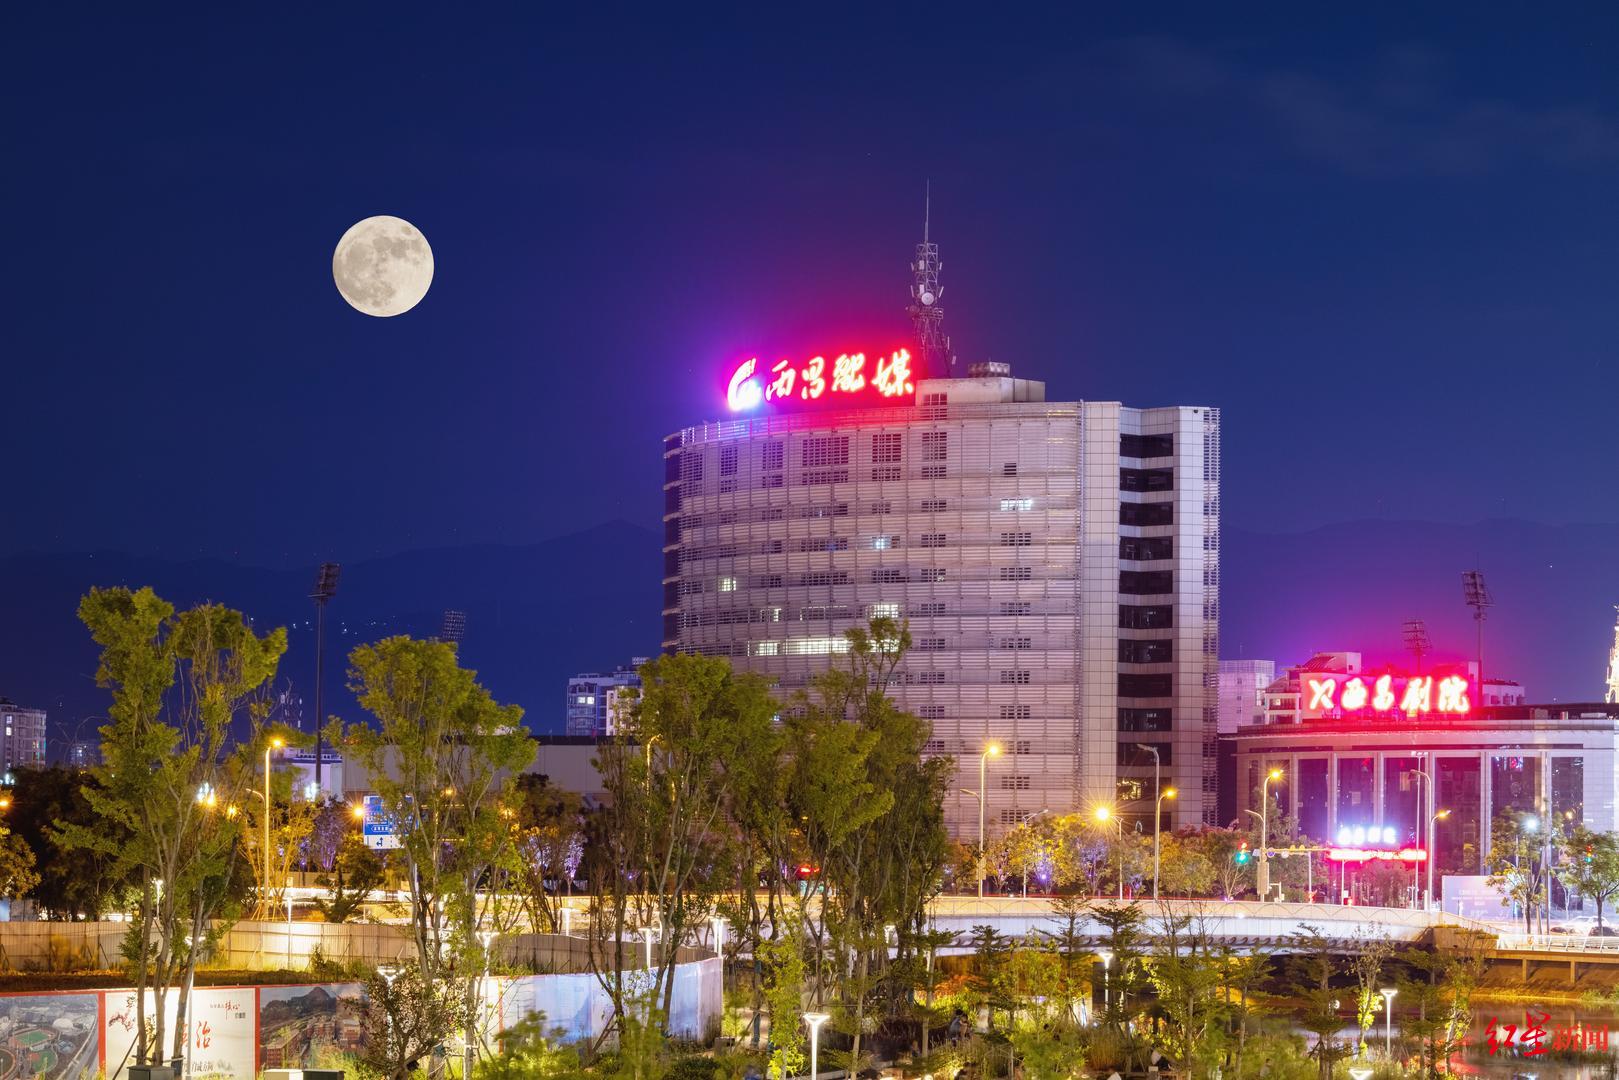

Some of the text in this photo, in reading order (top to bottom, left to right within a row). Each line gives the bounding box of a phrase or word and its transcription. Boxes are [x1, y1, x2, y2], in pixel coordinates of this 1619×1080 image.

[765, 348, 914, 401] 西昌融媒
[1341, 674, 1469, 712] 西昌剧院
